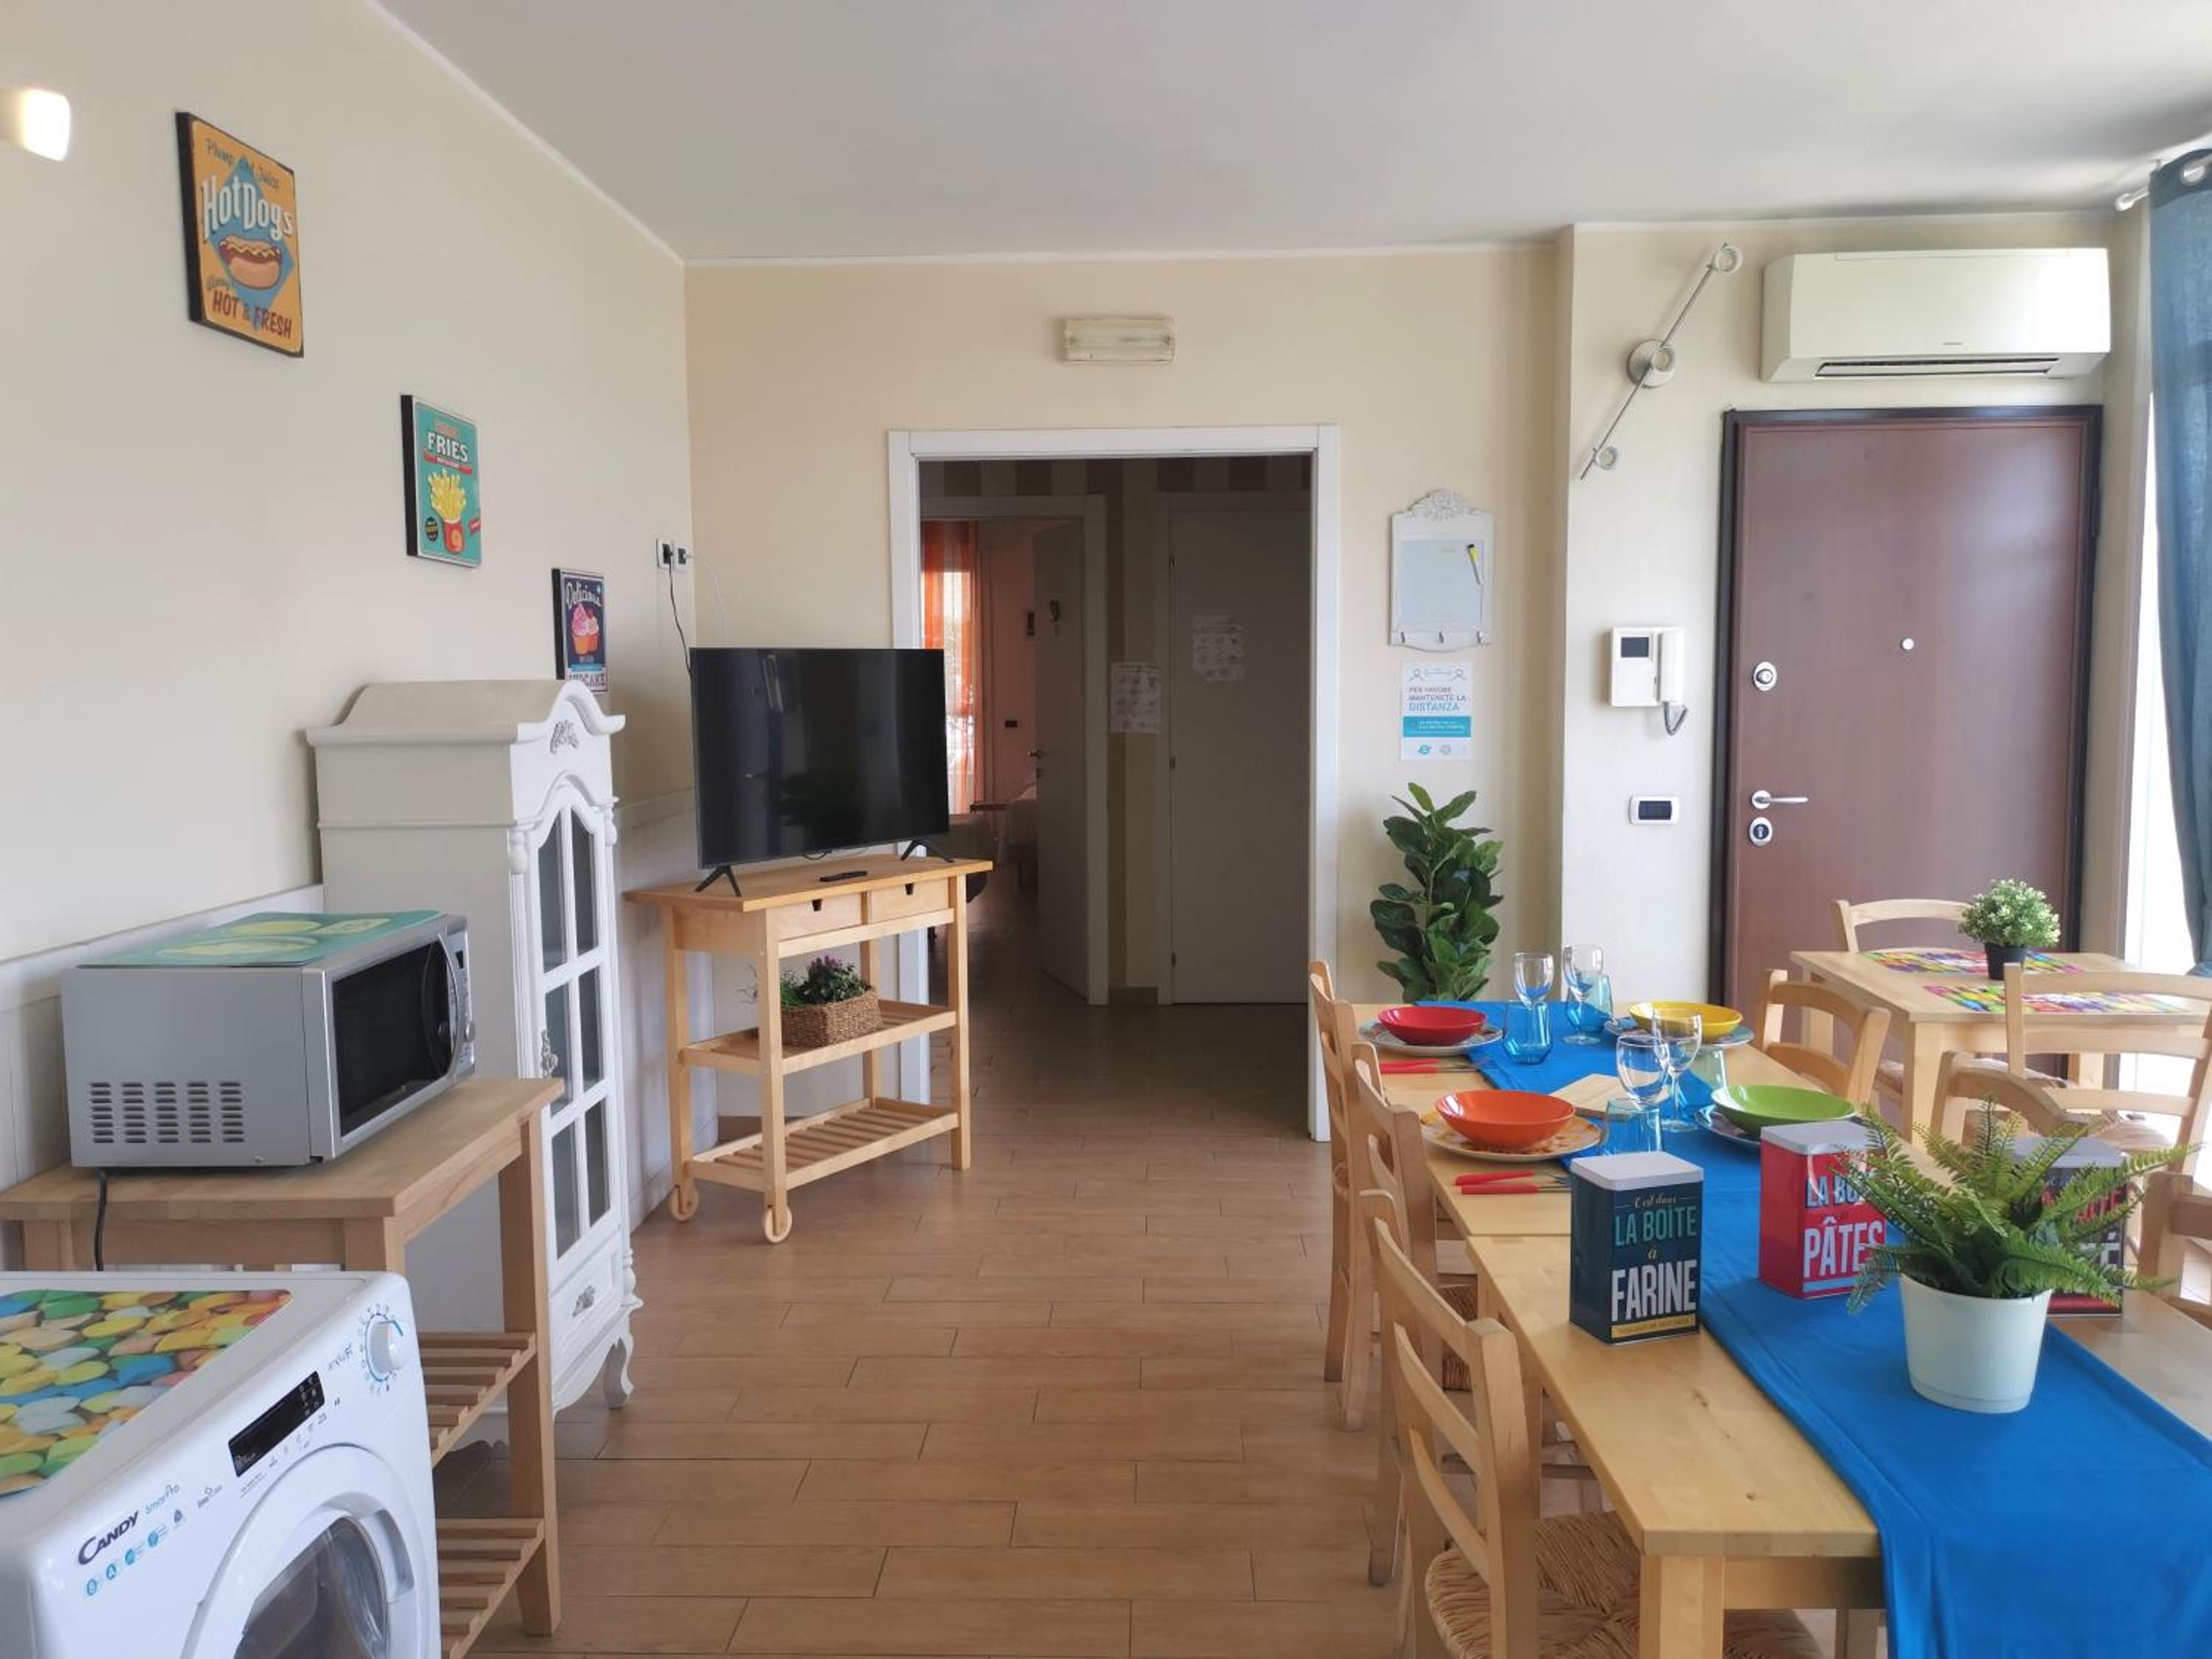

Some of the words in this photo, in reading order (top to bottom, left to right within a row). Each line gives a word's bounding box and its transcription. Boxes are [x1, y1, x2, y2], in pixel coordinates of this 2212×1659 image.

[212, 289, 239, 320] HOT
[254, 306, 292, 340] FRESH
[427, 431, 468, 462] FRIES
[1408, 702, 1460, 712] DISTANZA
[1806, 1175, 1829, 1208] LA
[1615, 1213, 1638, 1246] LA
[1611, 1259, 1698, 1322] FARINE
[78, 1509, 139, 1565] CANDY
